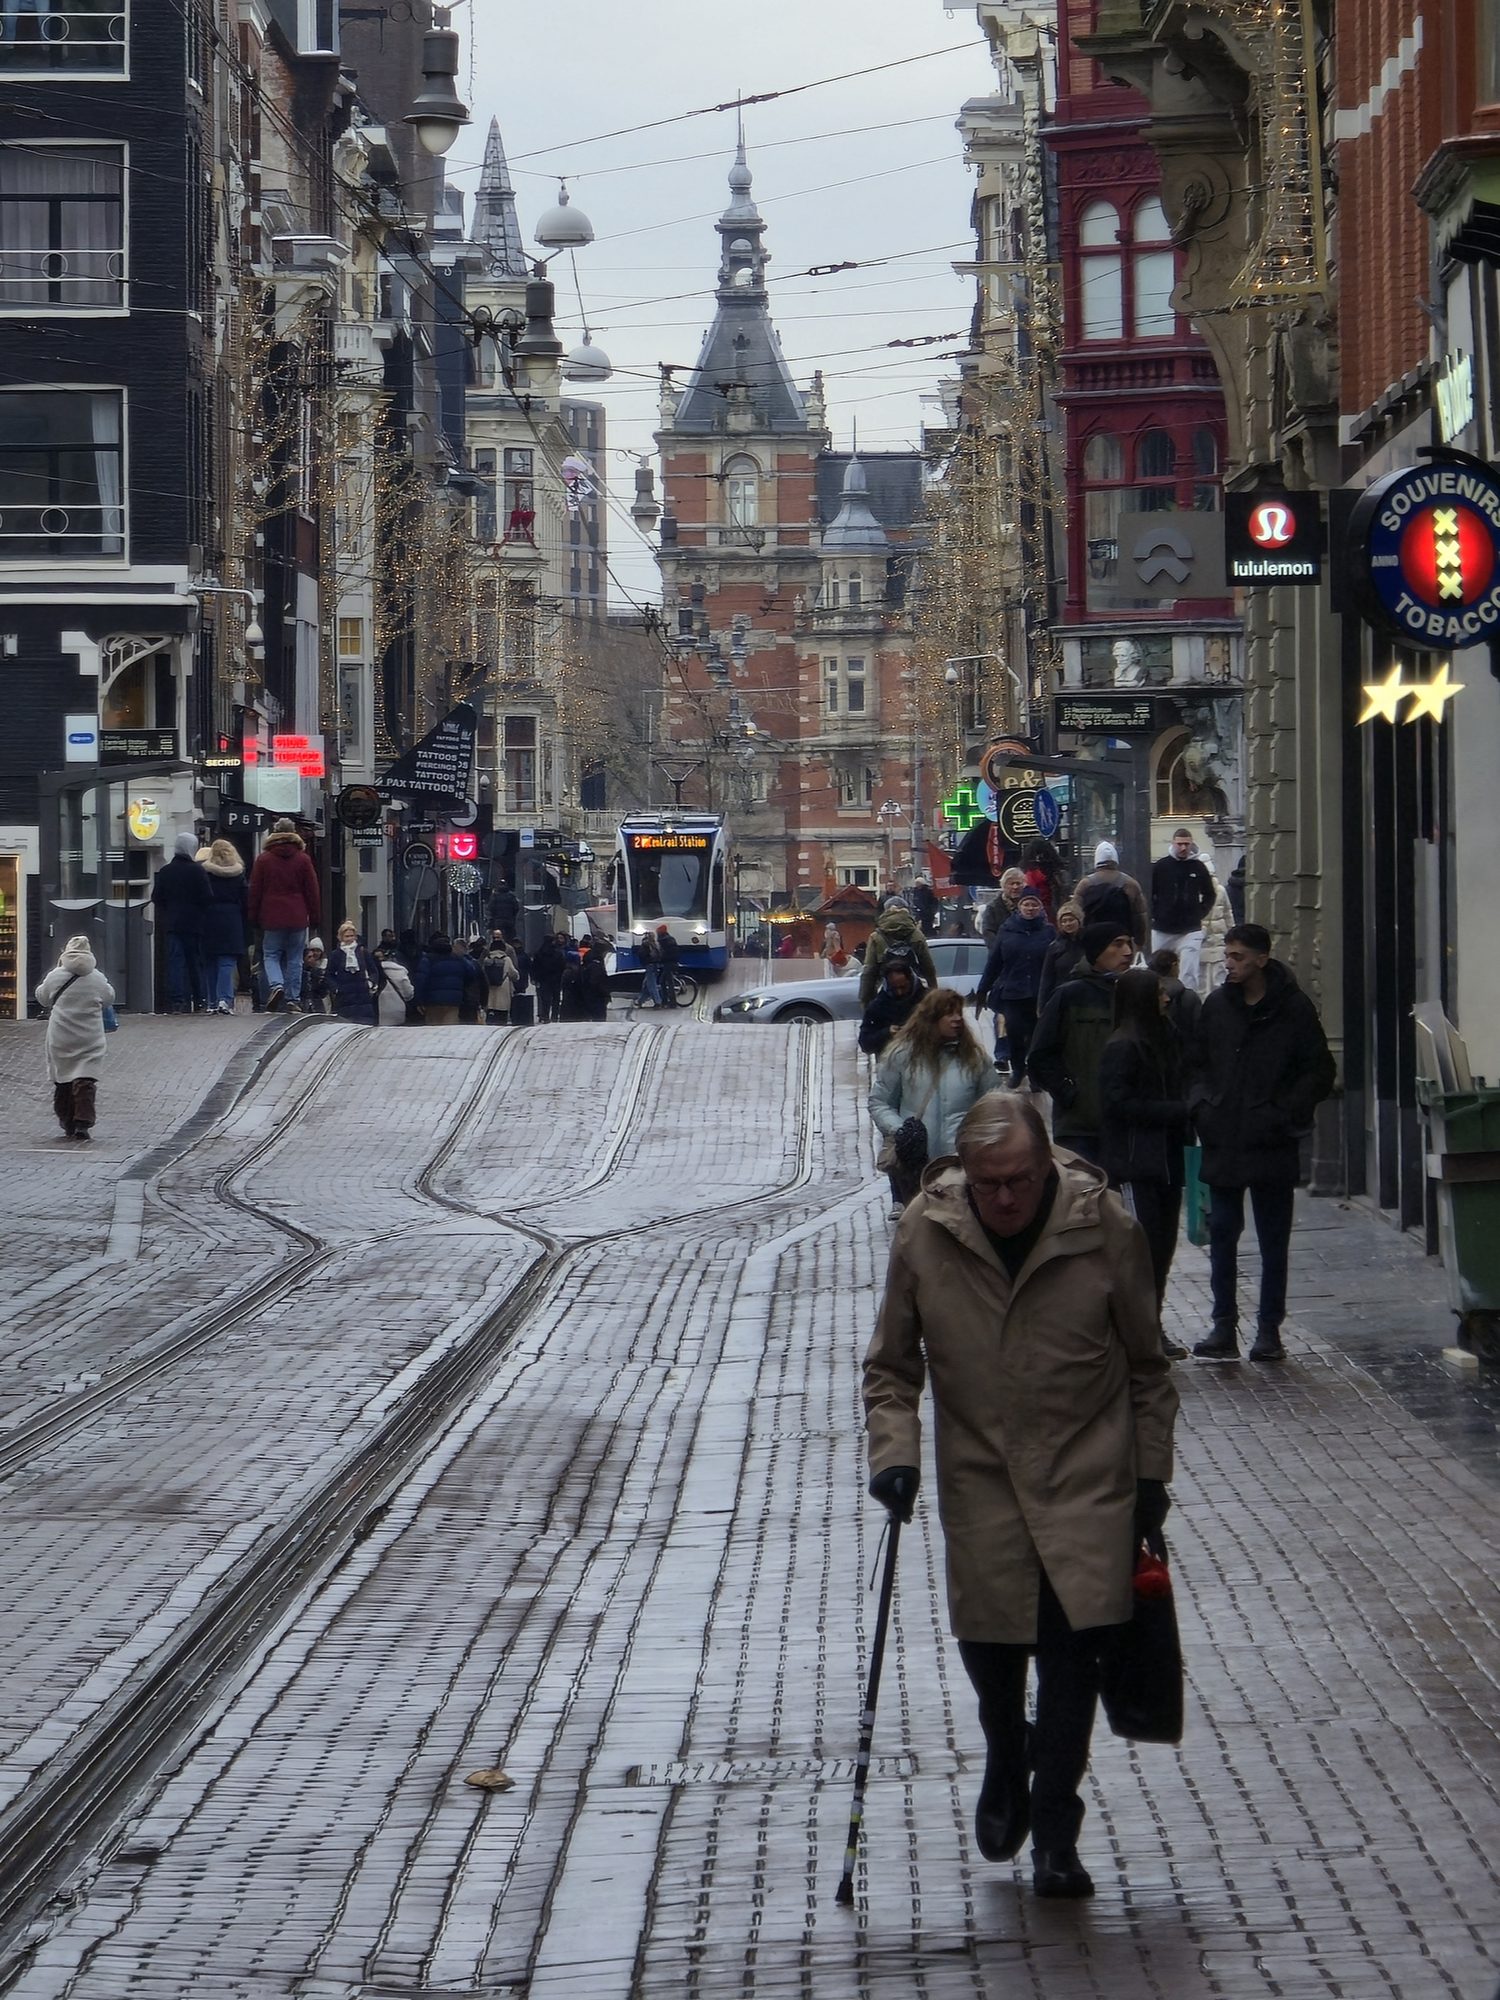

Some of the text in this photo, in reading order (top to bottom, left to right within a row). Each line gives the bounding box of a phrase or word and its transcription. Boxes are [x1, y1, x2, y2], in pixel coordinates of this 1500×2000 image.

[1233, 560, 1313, 577] lululemon
[417, 751, 457, 761] TATTOOS
[205, 759, 241, 767] SECRID
[416, 761, 457, 772] PIERCINGS
[415, 771, 456, 781] TATTOOS
[387, 778, 407, 788] PAX
[409, 780, 455, 793] TATTOOS
[229, 813, 238, 826] P
[255, 813, 265, 826] T
[634, 836, 641, 848] 2
[680, 835, 707, 848] Station
